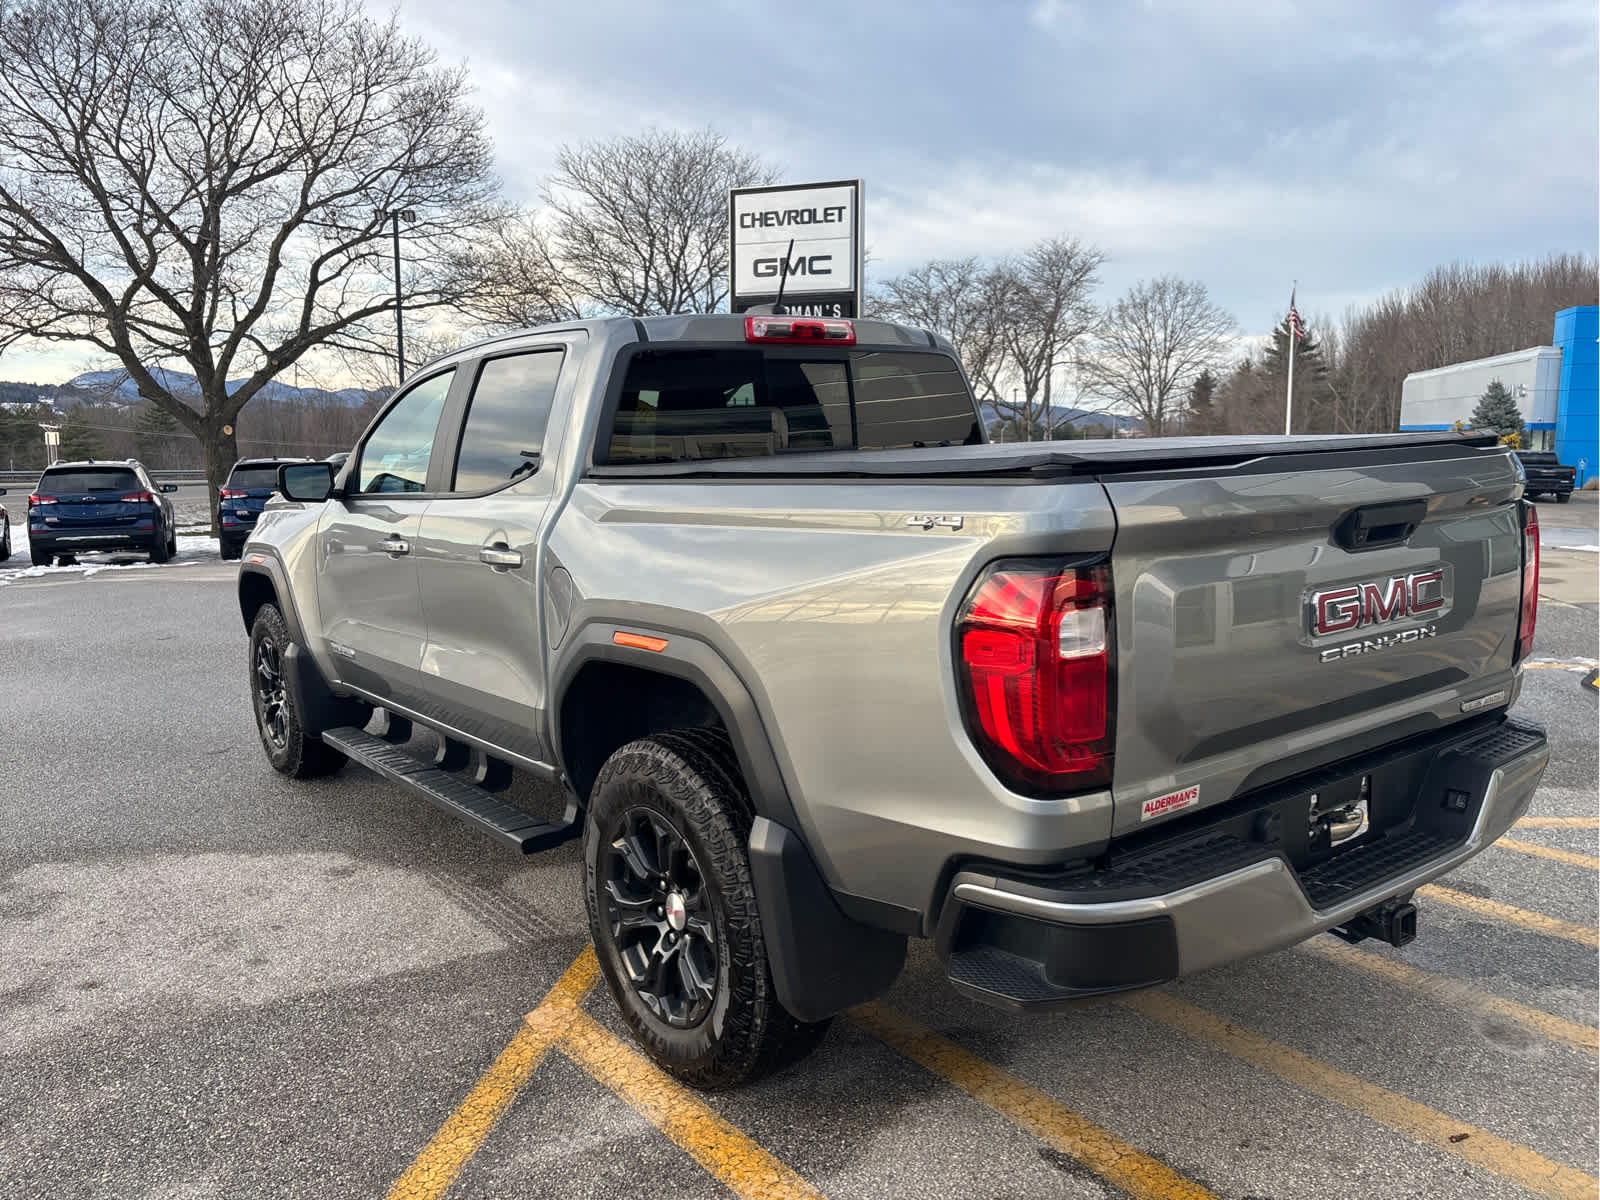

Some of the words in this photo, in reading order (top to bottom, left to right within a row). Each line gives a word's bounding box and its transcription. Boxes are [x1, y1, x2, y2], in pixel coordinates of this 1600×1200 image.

[740, 206, 846, 228] CHEVROLET
[753, 255, 832, 277] GMC
[1312, 570, 1444, 635] GMC
[1320, 625, 1437, 663] CANYON
[1144, 787, 1197, 814] ALDERMAN'S
